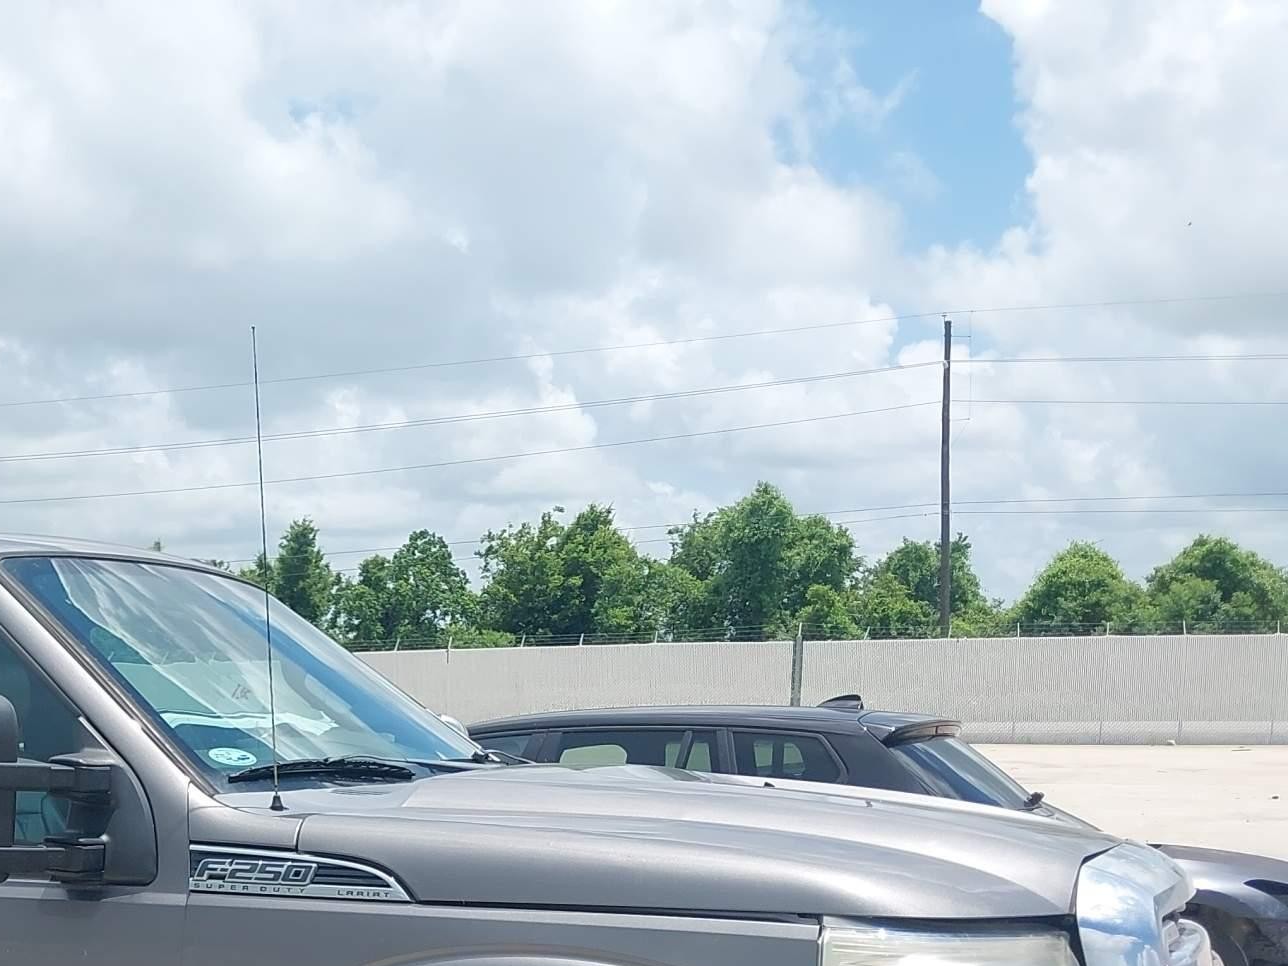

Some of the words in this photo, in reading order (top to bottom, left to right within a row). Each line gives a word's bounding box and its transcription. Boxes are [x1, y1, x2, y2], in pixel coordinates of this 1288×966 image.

[193, 882, 250, 892] SUPER
[259, 886, 306, 894] DUTY
[336, 889, 391, 898] LARIAT
